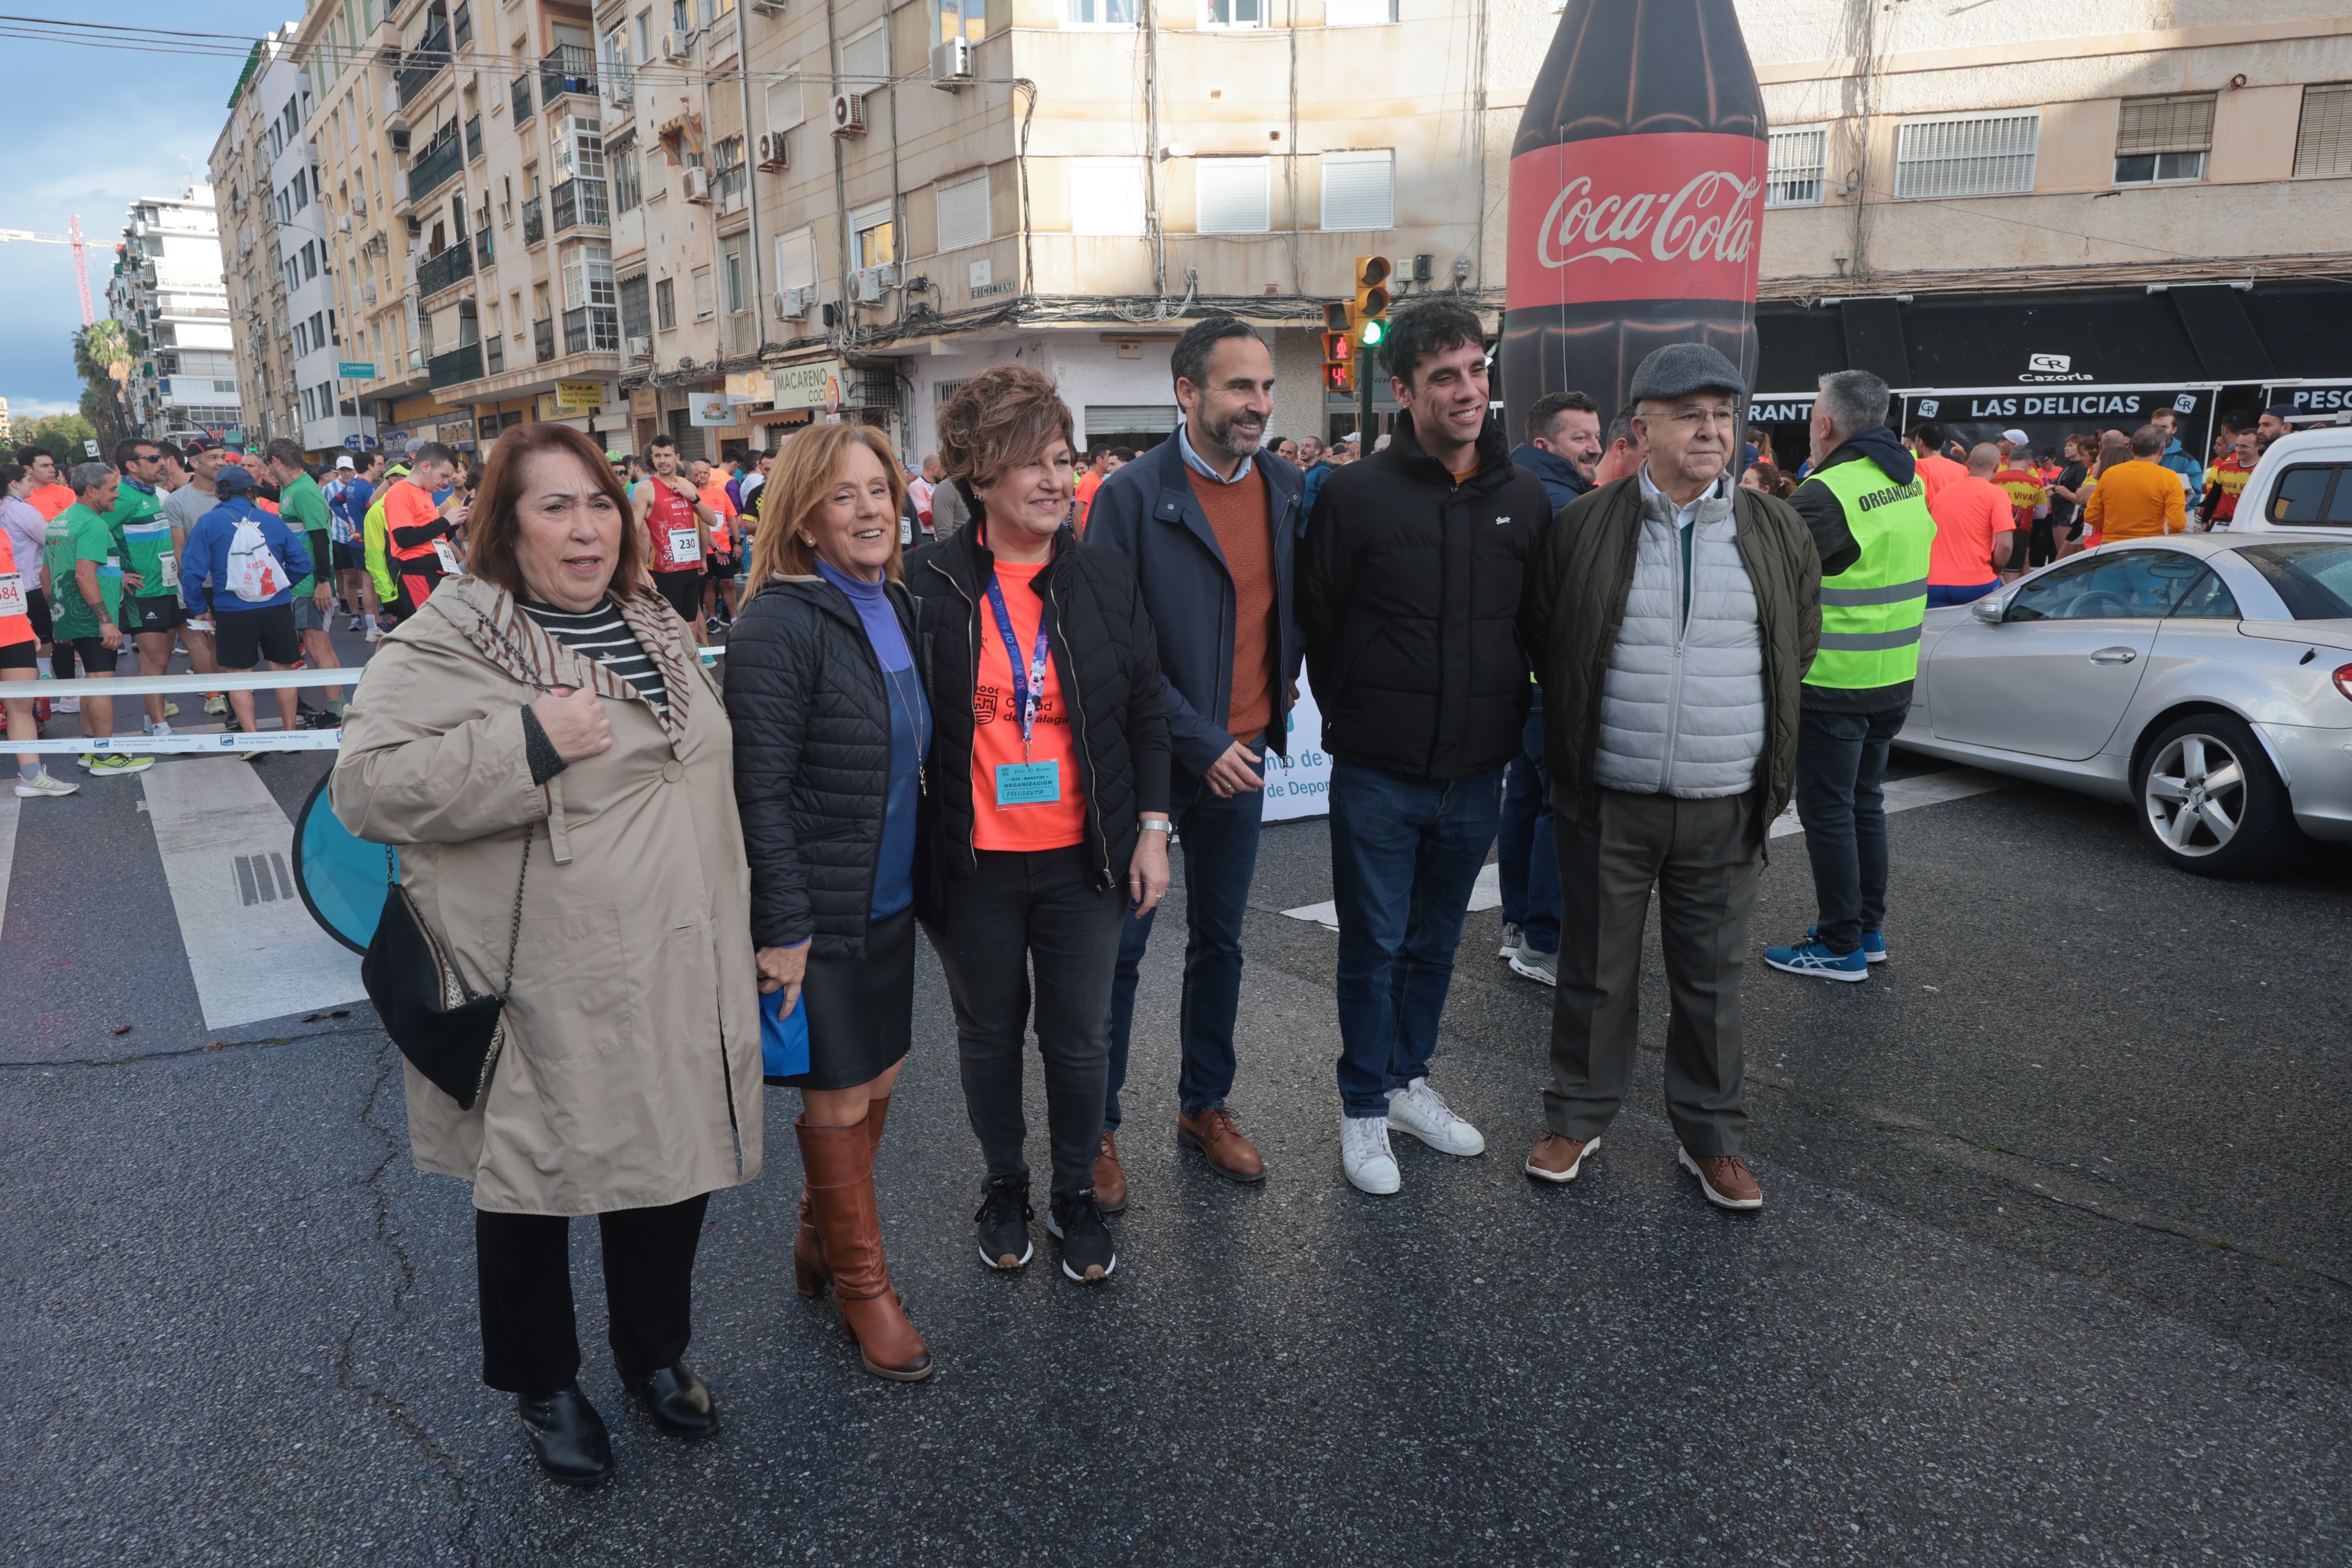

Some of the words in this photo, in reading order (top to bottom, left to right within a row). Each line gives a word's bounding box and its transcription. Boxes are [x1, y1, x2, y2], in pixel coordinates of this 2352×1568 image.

[777, 368, 828, 391] MACARENO
[2018, 372, 2094, 382] Cazorla
[1971, 399, 2017, 417] LAS
[2024, 396, 2140, 414] DELICIAS
[2014, 492, 2037, 502] VIVA!
[679, 539, 695, 549] 230
[994, 600, 1010, 630] MAGIC
[1004, 632, 1014, 644] OF
[1010, 646, 1023, 675] YEARS
[1017, 678, 1025, 690] 30
[1301, 749, 1323, 768] de
[1267, 783, 1285, 798] de
